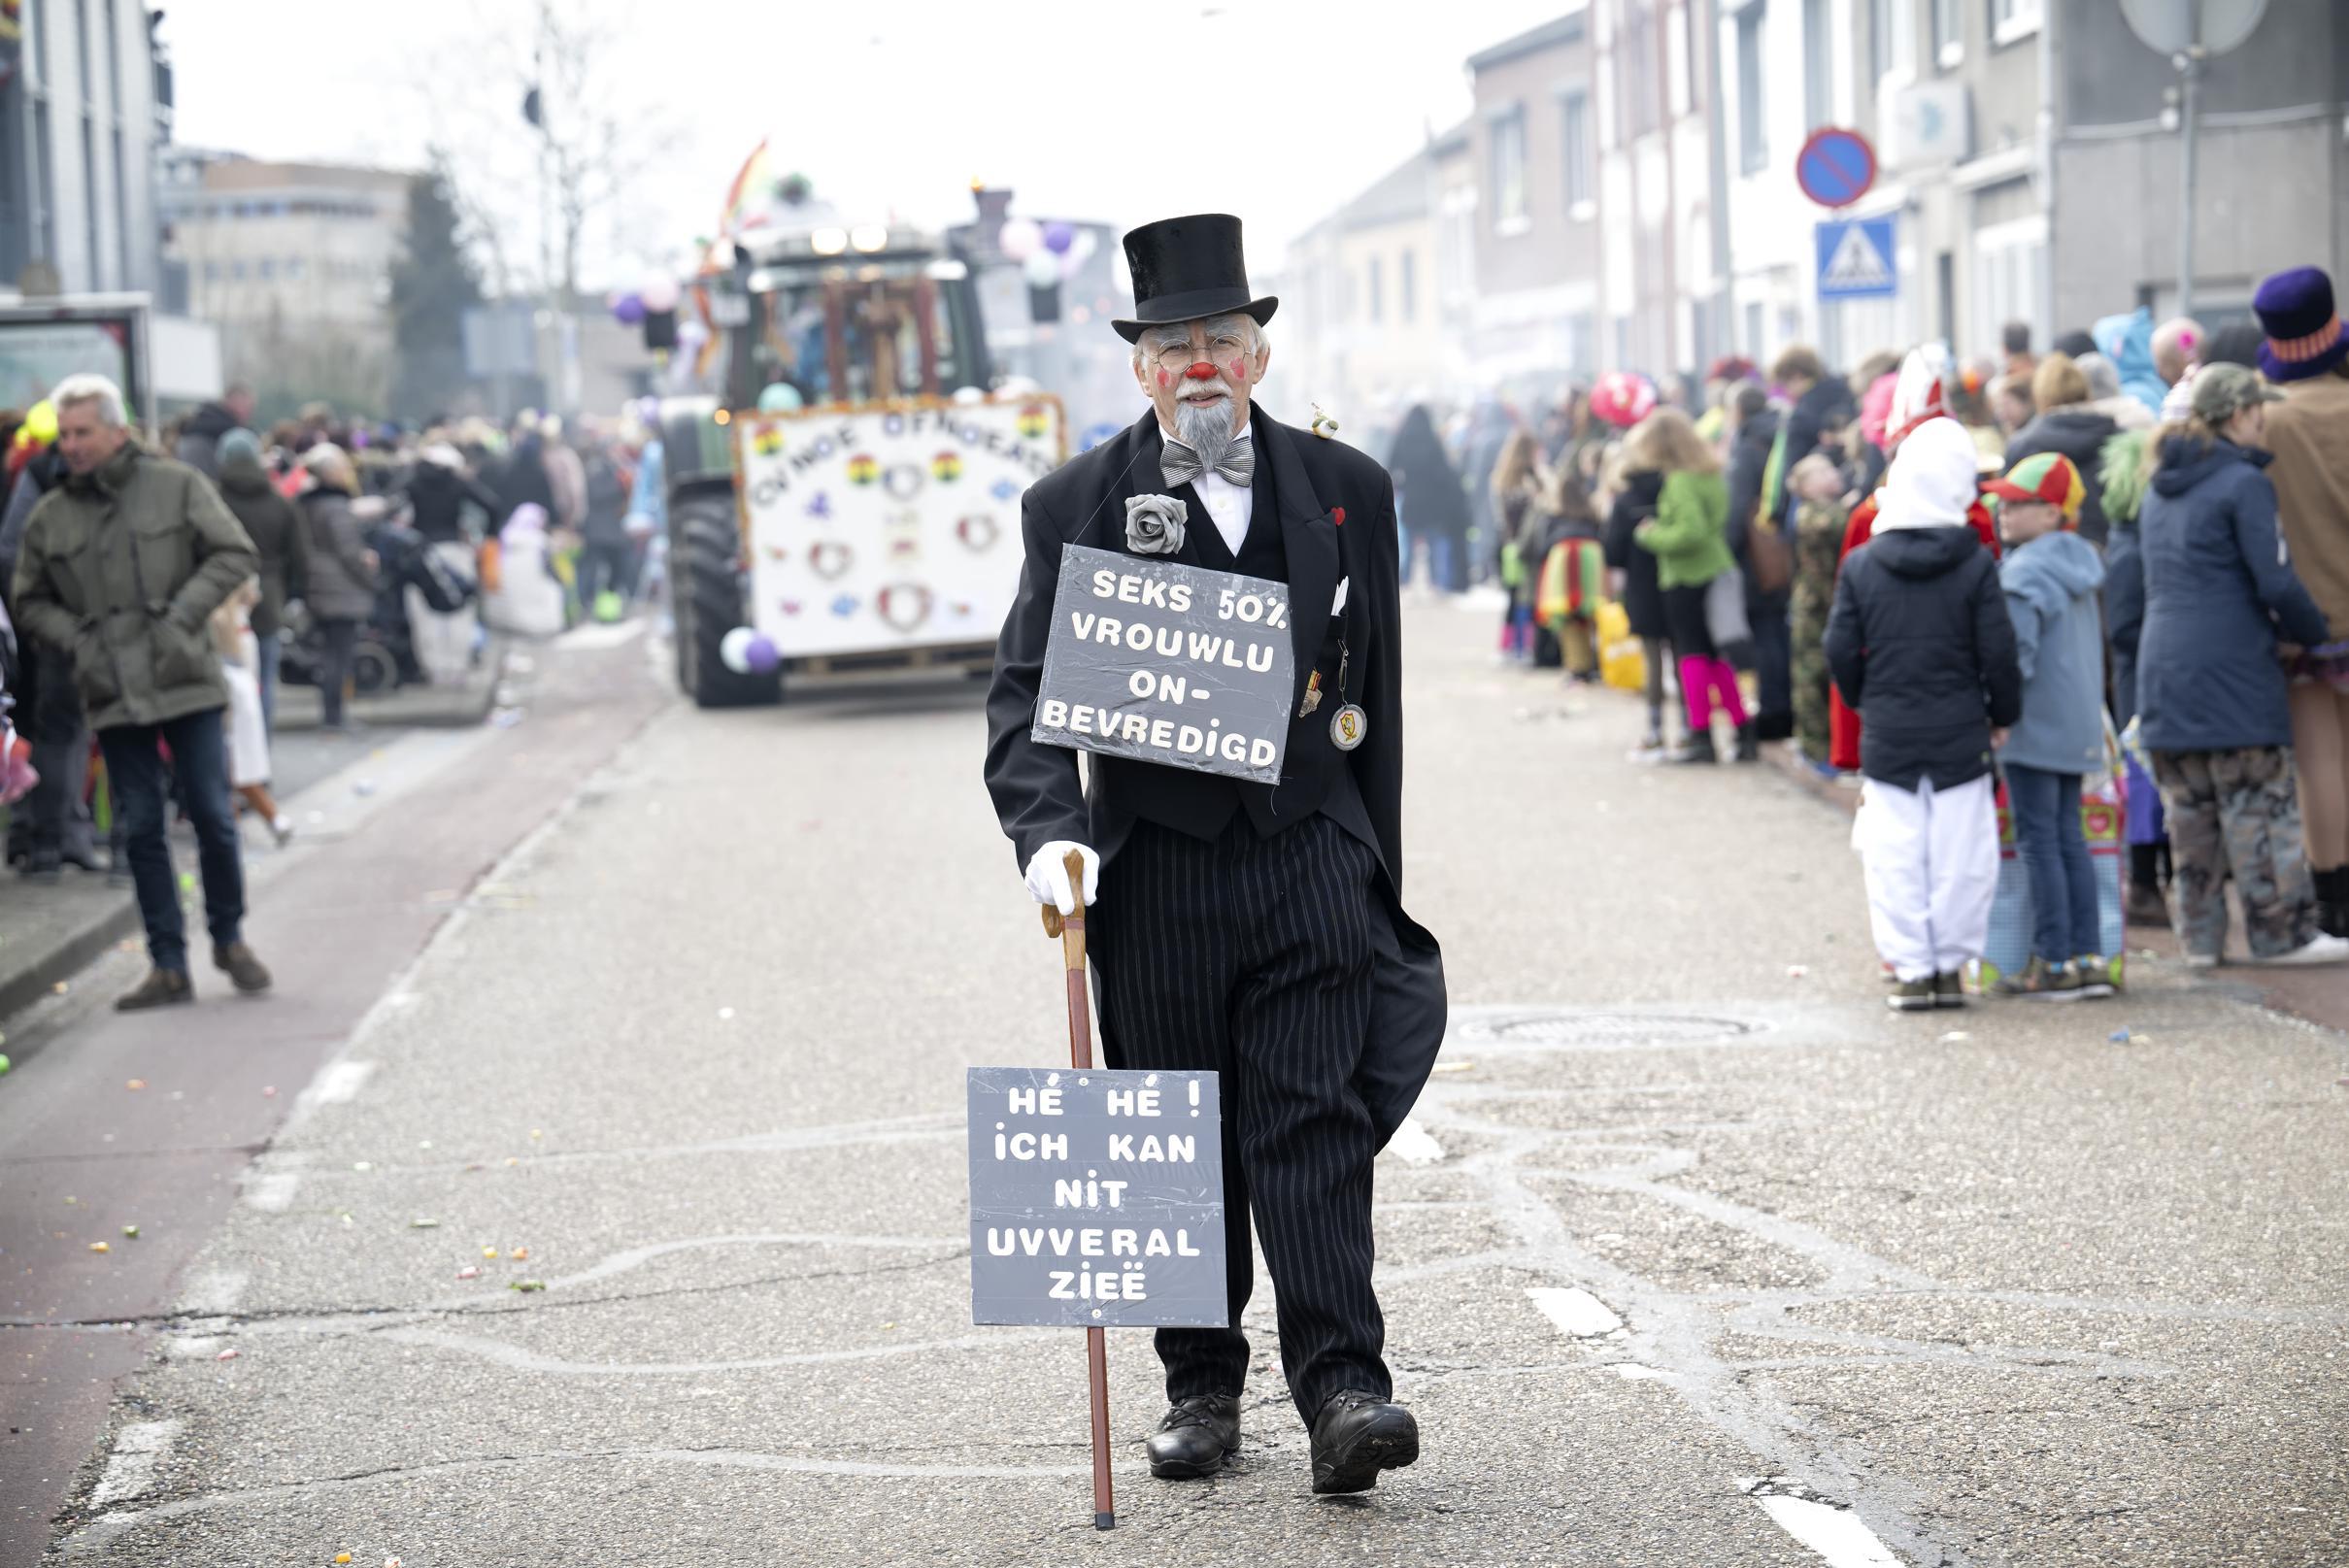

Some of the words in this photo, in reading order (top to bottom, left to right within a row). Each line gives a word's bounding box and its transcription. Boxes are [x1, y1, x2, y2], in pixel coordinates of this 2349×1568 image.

[1093, 570, 1192, 613] SEKS
[1218, 589, 1288, 630] 50%
[1071, 612, 1274, 673] VROUWLU
[1128, 669, 1211, 705] ON-
[1009, 1072, 1064, 1116] HÉ
[1107, 1073, 1161, 1118] HÉ
[1188, 1079, 1200, 1118] !
[1109, 1133, 1195, 1163] KAN
[988, 1227, 1200, 1257] UVVERAL
